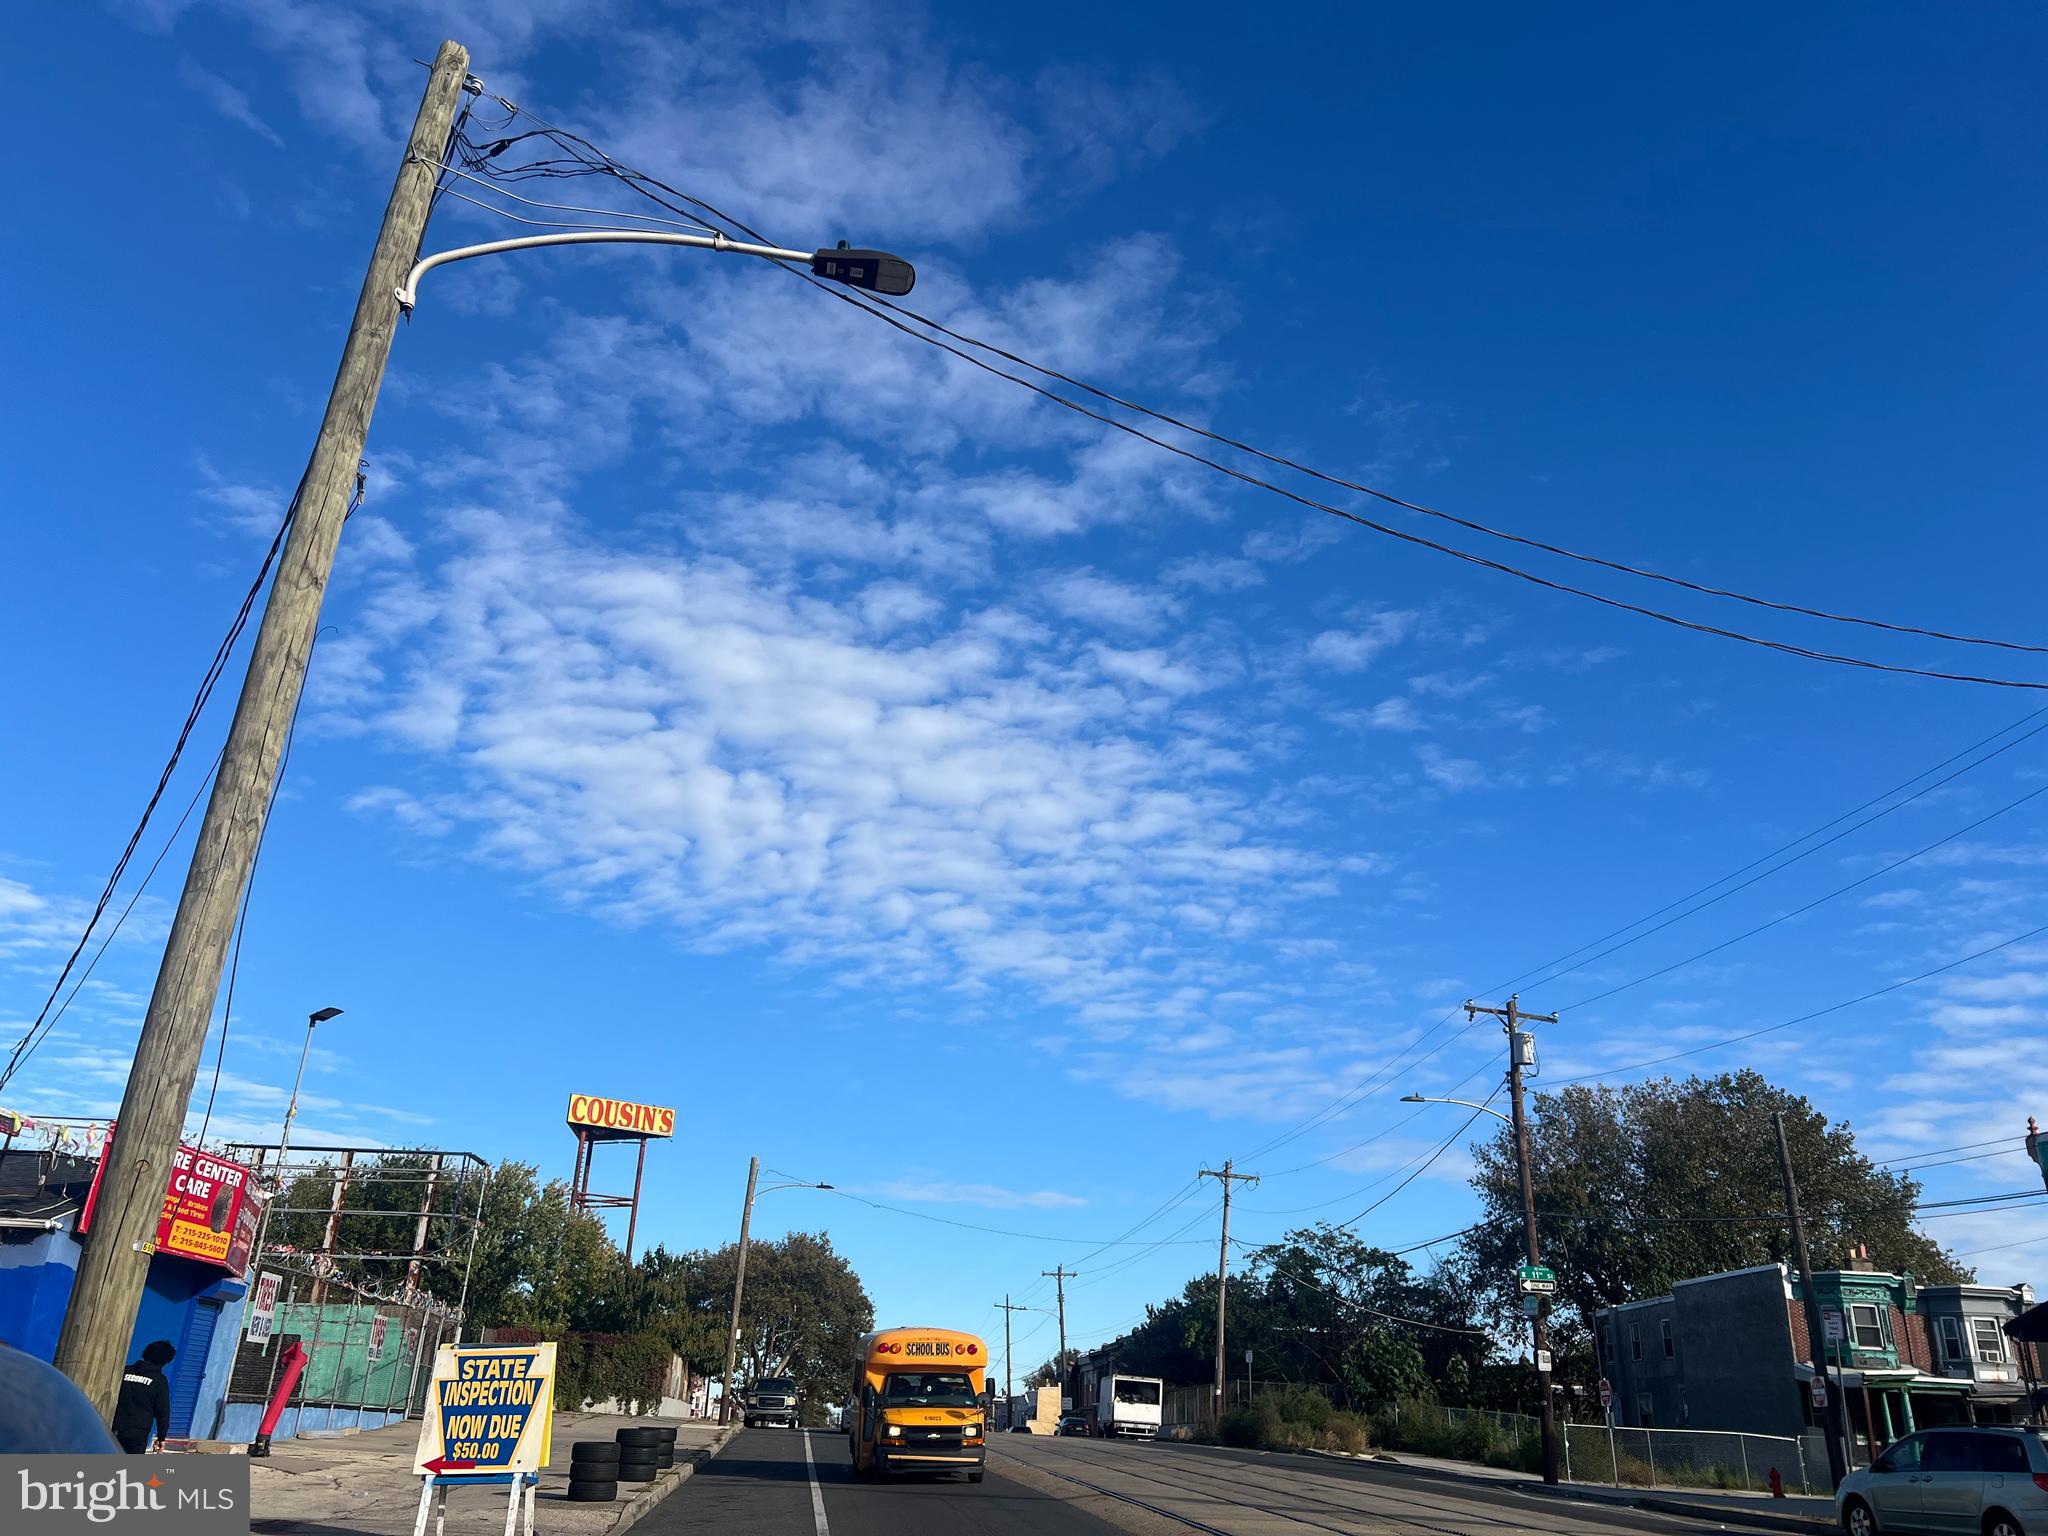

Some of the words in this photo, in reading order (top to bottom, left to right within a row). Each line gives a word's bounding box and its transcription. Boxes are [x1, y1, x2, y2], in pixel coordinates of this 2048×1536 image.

[571, 1097, 674, 1134] COUSIN'S
[195, 1159, 243, 1188] CENTER
[175, 1175, 212, 1199] CARE
[183, 1227, 228, 1245] 215-225-1010
[906, 1342, 934, 1356] SCHOOL
[936, 1343, 950, 1356] BUS
[124, 1374, 153, 1385] SECURITY
[462, 1358, 527, 1380] STATE
[443, 1380, 536, 1407] INSPECTION
[446, 1415, 488, 1440] NOW
[488, 1414, 522, 1440] DUE
[452, 1441, 500, 1462] $50.00
